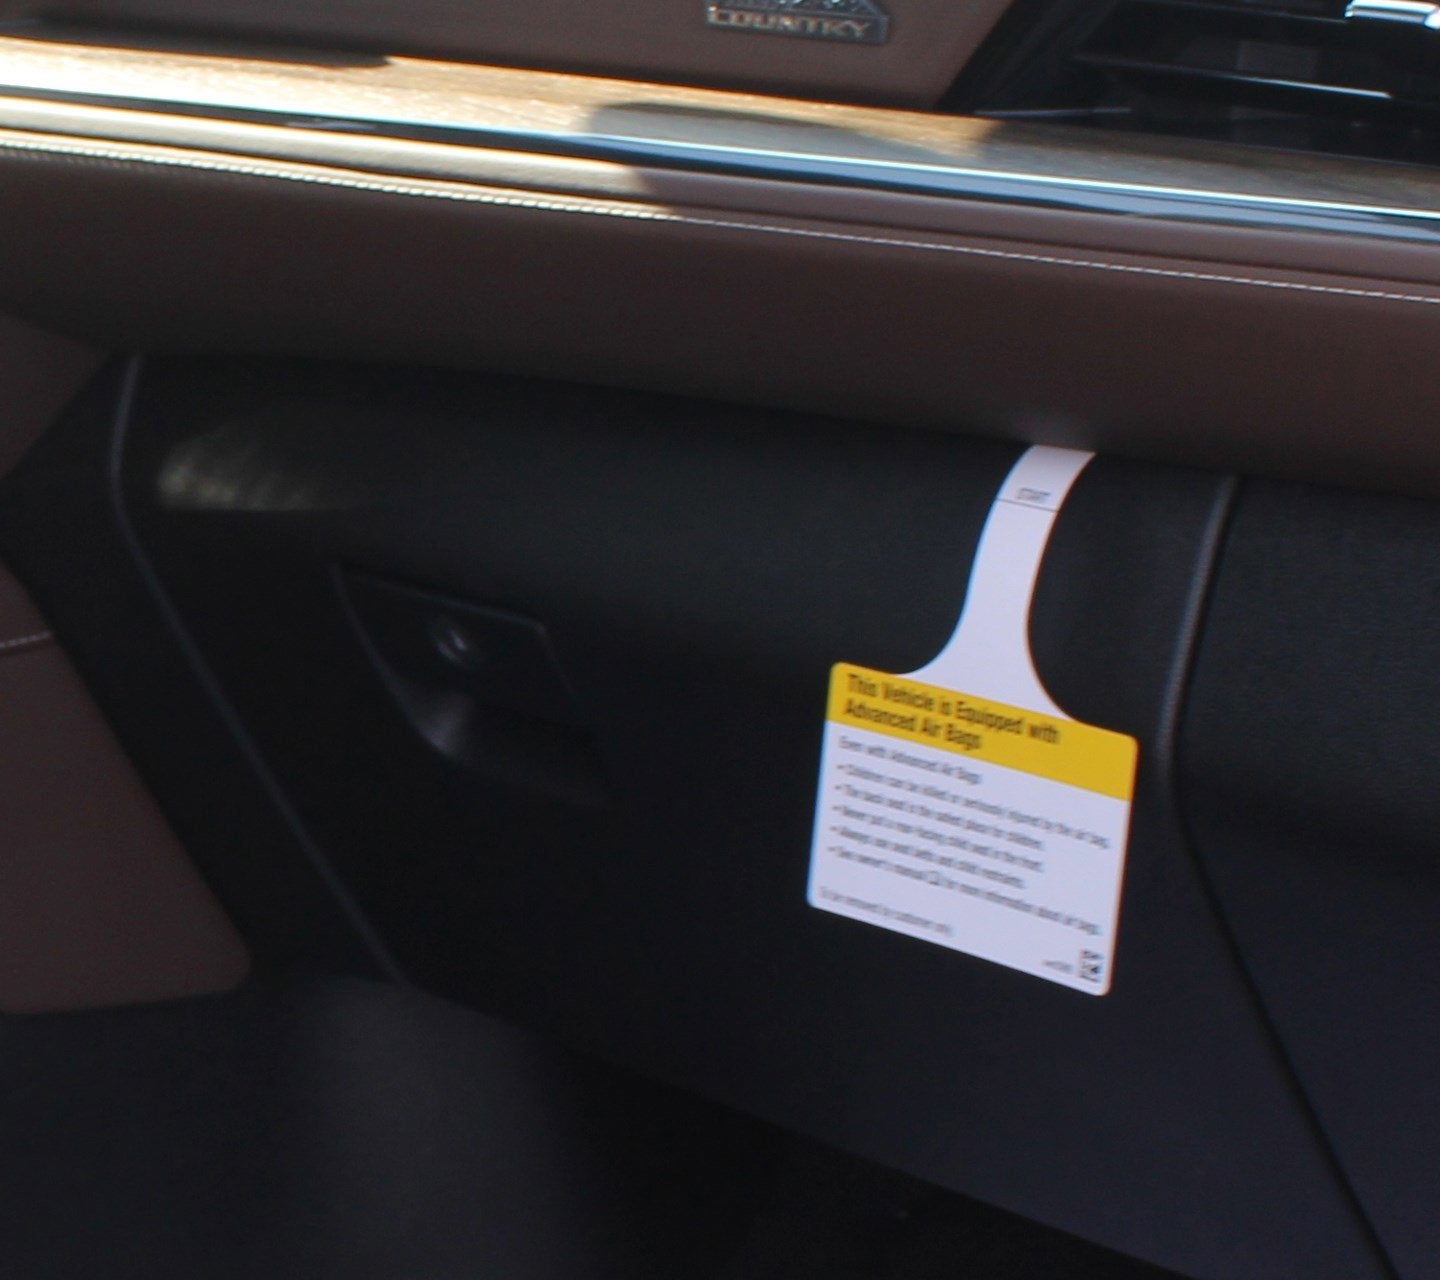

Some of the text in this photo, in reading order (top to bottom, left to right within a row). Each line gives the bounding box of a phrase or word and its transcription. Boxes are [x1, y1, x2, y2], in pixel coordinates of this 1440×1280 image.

[845, 699, 980, 750] Advanced Air Bags
[848, 674, 1058, 741] This Vehicle is Equipped with
